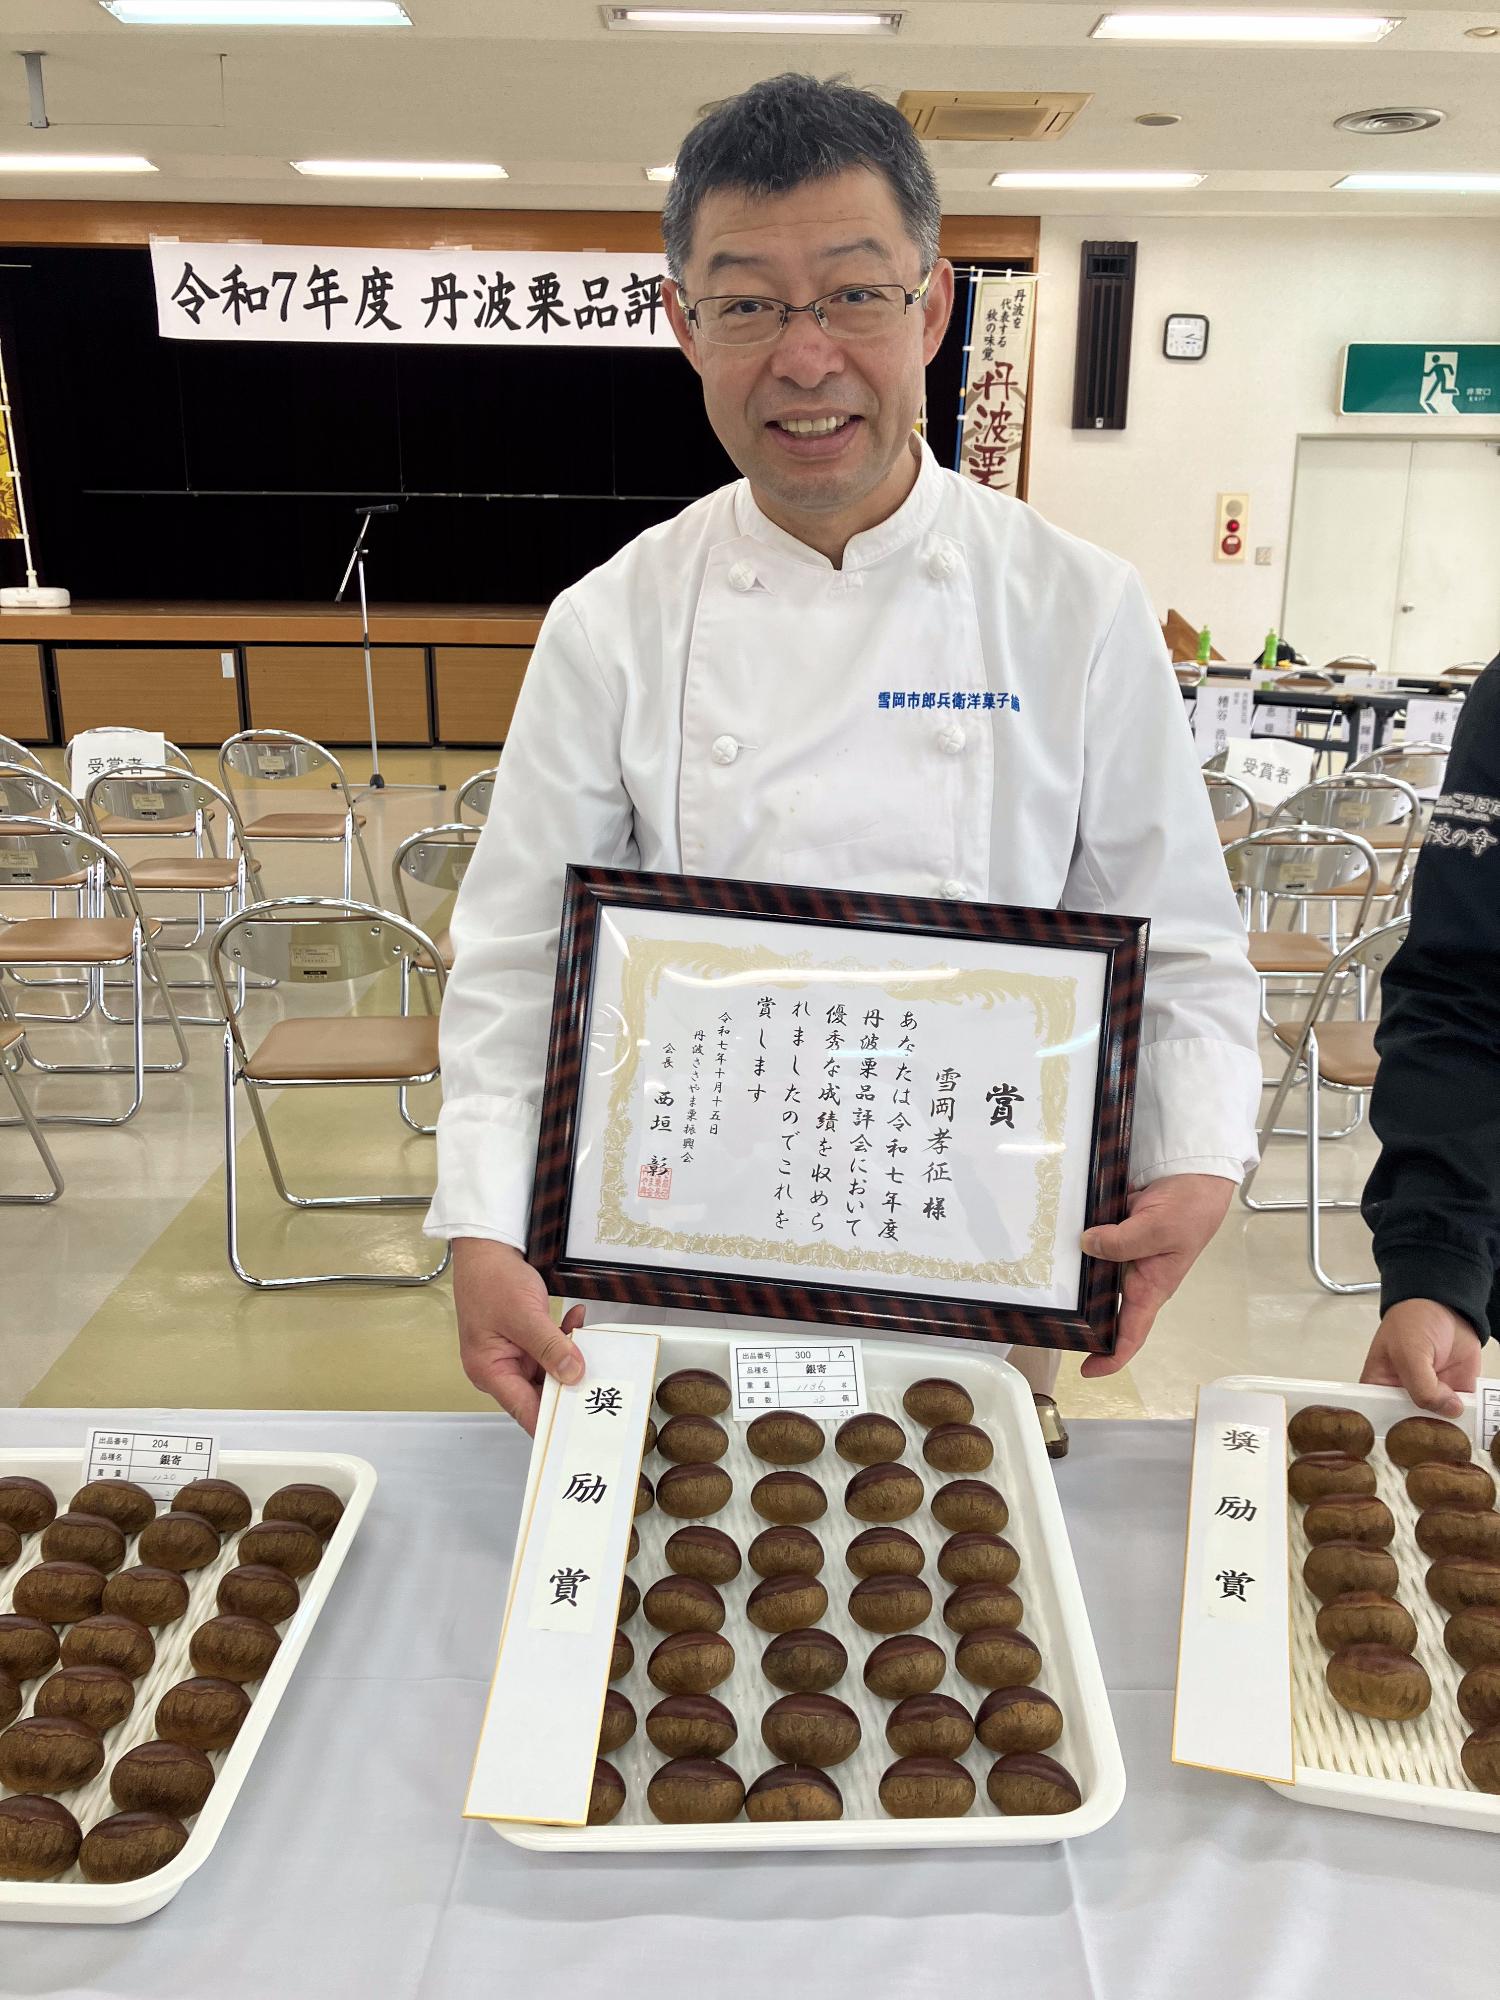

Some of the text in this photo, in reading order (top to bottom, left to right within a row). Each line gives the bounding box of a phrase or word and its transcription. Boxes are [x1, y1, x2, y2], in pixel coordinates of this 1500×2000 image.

[171, 261, 402, 331] 令和7年度
[998, 298, 1013, 348] 代表する
[1012, 288, 1026, 329] 丹波を
[982, 308, 998, 362] 秋の味覚
[1241, 757, 1291, 784] 受賞者
[662, 1043, 677, 1068] 会長
[709, 1012, 732, 1135] 令和七年十月十五日
[747, 996, 776, 1104] 賞します
[680, 1030, 706, 1163] 丹波ささやま栗振興会
[774, 1000, 811, 1229] れましたのでこれを
[810, 1003, 848, 1232] 優秀な成績を収めら
[846, 1008, 884, 1237] 丹波栗品評会において
[878, 1010, 918, 1242] あなたは令和七年度
[985, 1083, 1024, 1129] 賞
[742, 1350, 846, 1360] 出品番号 300 A
[806, 1364, 827, 1375] 銀寄
[98, 1437, 203, 1450] 出品番号 204 B
[100, 1453, 182, 1466] 品種名 銀寄
[549, 1387, 623, 1607] 奨励賞
[1214, 1429, 1260, 1602] 奨励賞
